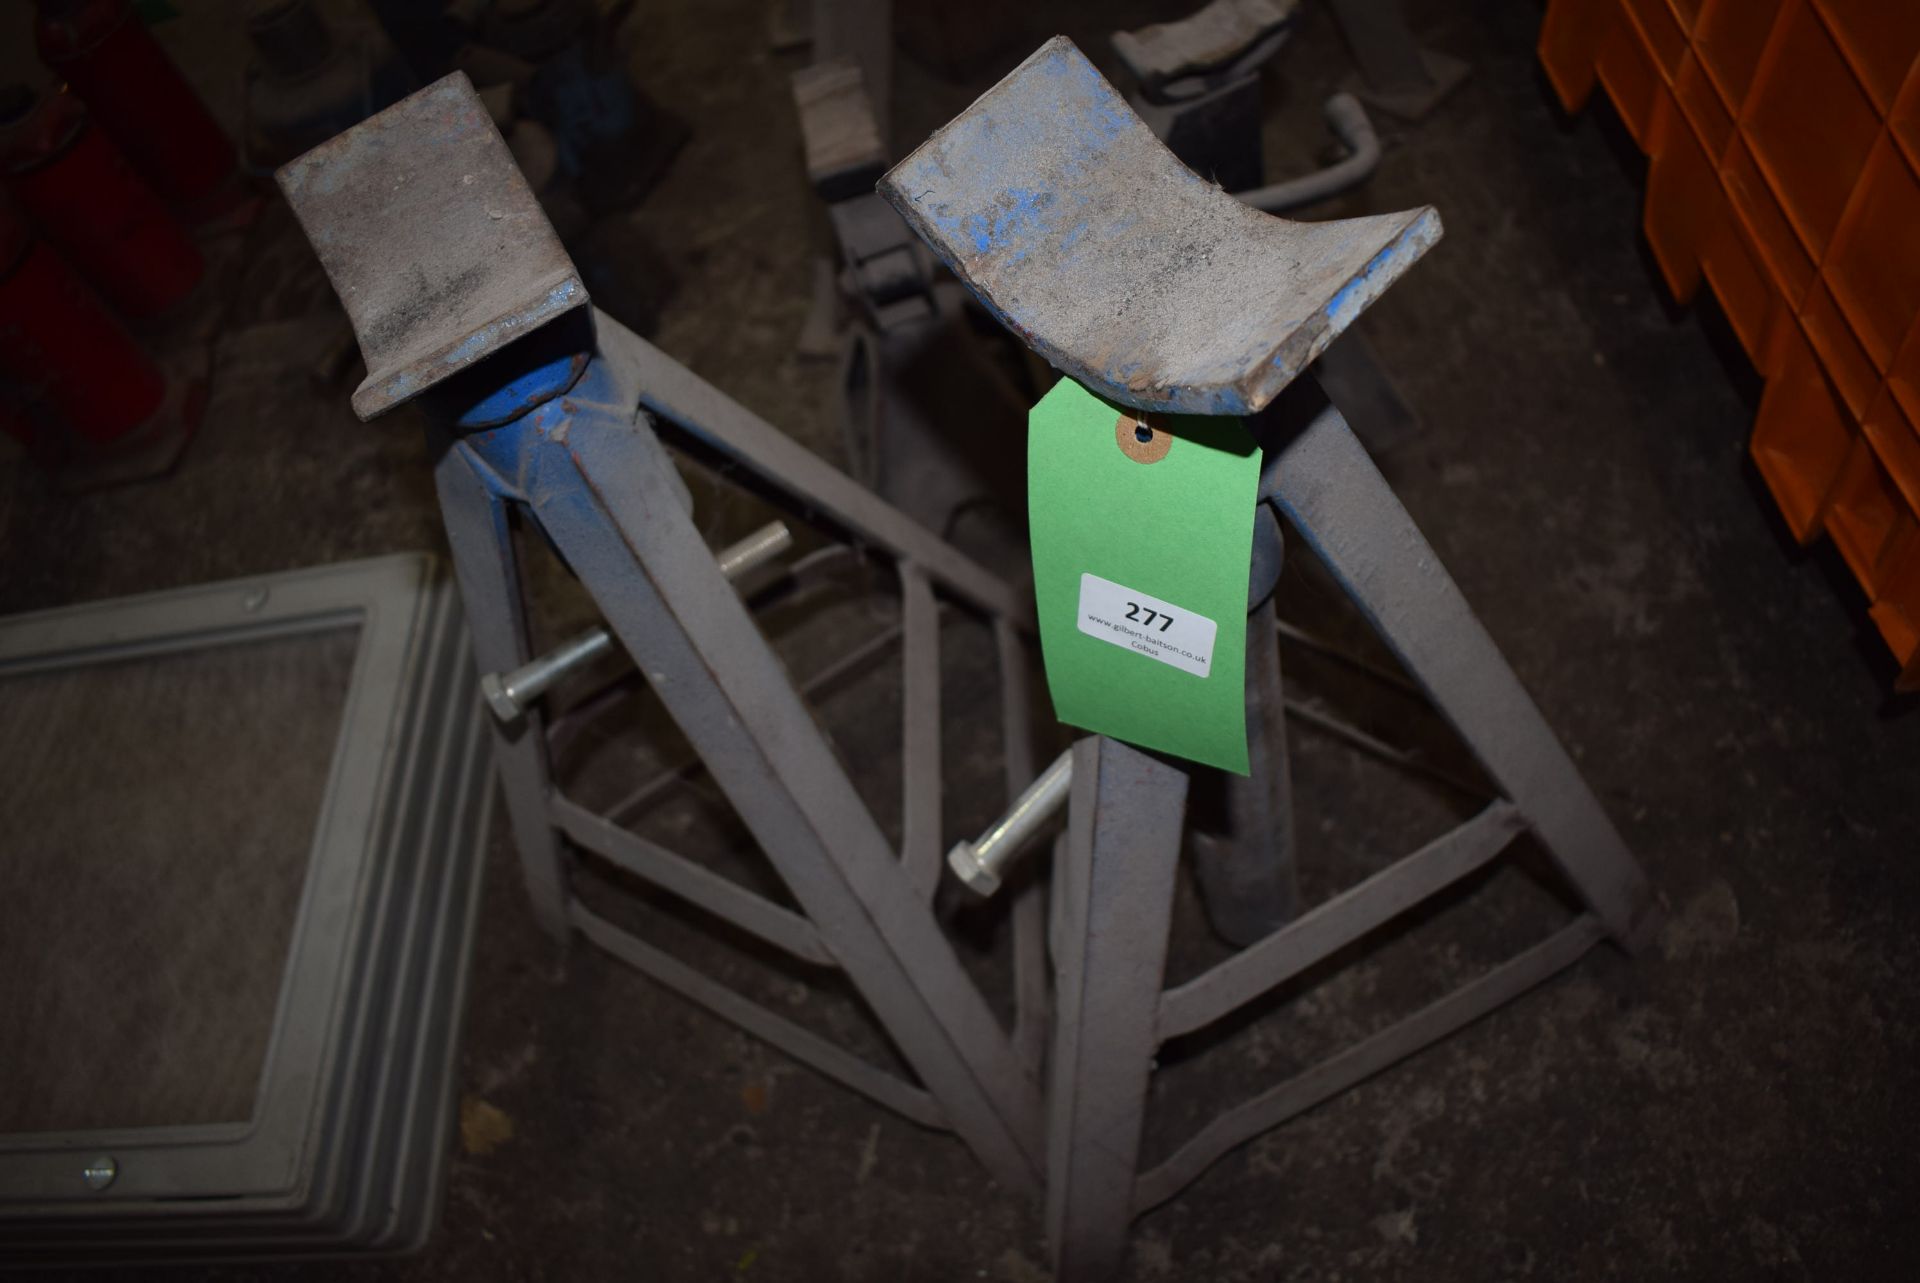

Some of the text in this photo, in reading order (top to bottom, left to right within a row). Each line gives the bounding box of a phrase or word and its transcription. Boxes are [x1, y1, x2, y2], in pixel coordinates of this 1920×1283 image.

[1125, 601, 1174, 632] 277
[1087, 614, 1207, 664] www.gilbert-baitson.co.uk
[1131, 640, 1159, 656] Cobus
